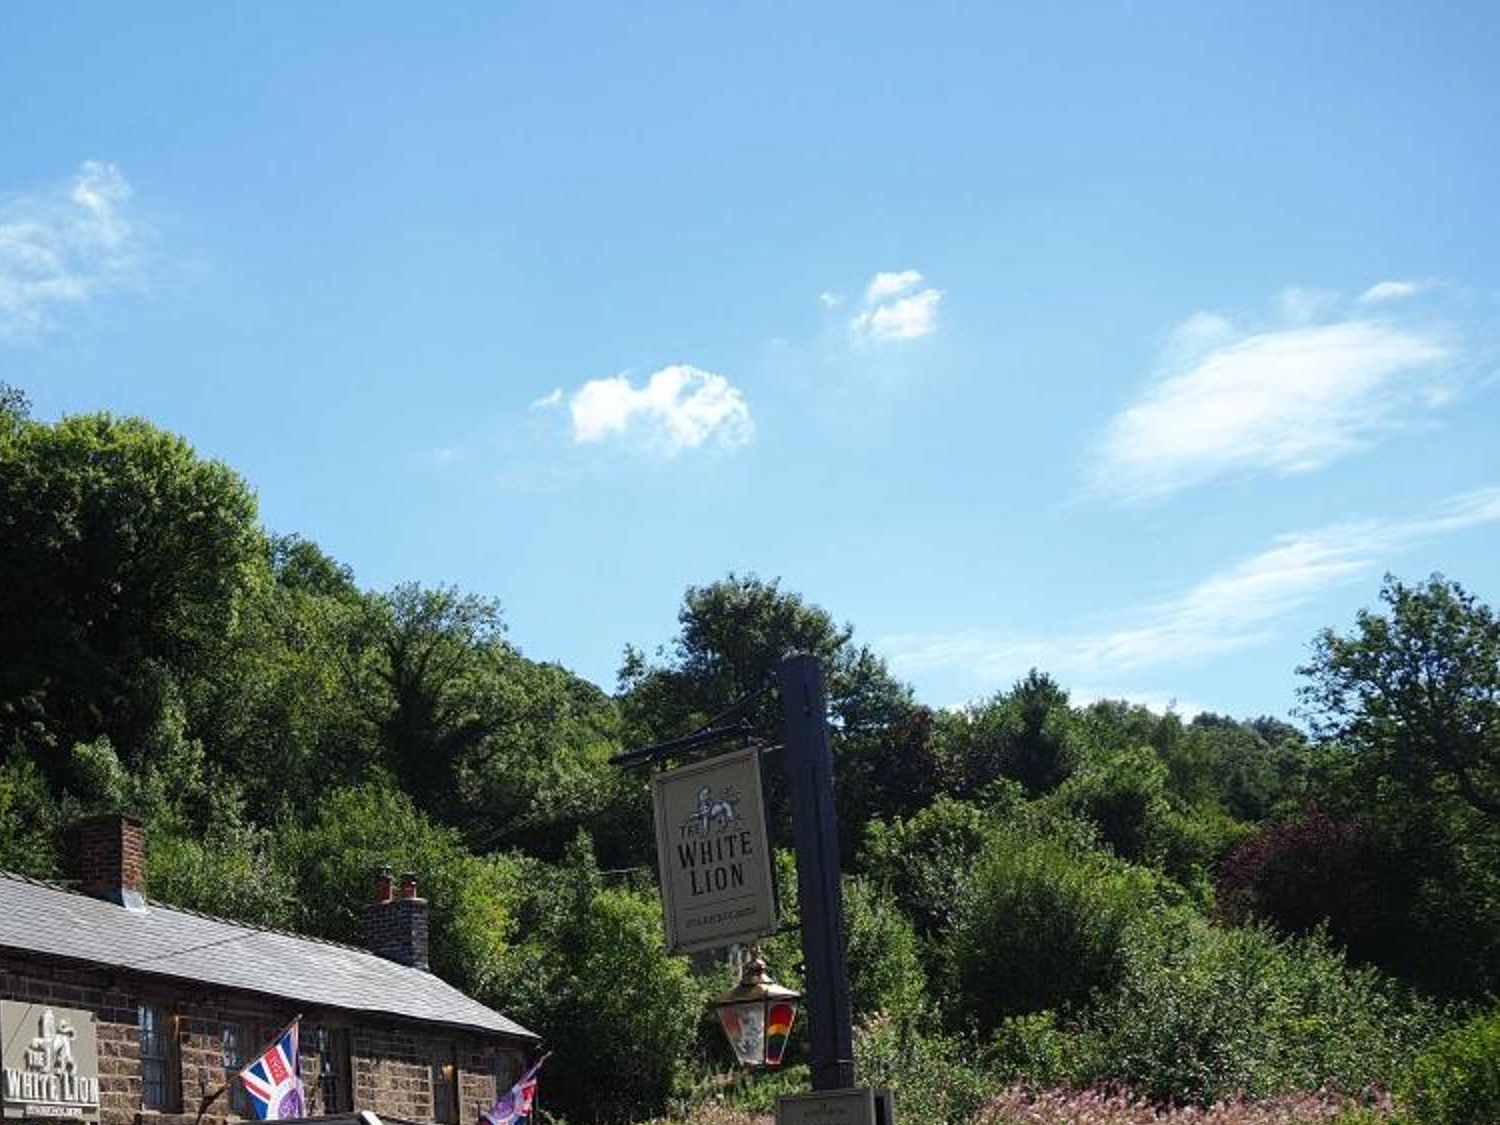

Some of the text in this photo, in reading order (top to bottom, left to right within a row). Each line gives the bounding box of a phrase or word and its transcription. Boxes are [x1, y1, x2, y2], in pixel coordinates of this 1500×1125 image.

[677, 831, 753, 868] WHITE
[691, 862, 744, 896] LION
[6, 1067, 99, 1103] WHITE LION
